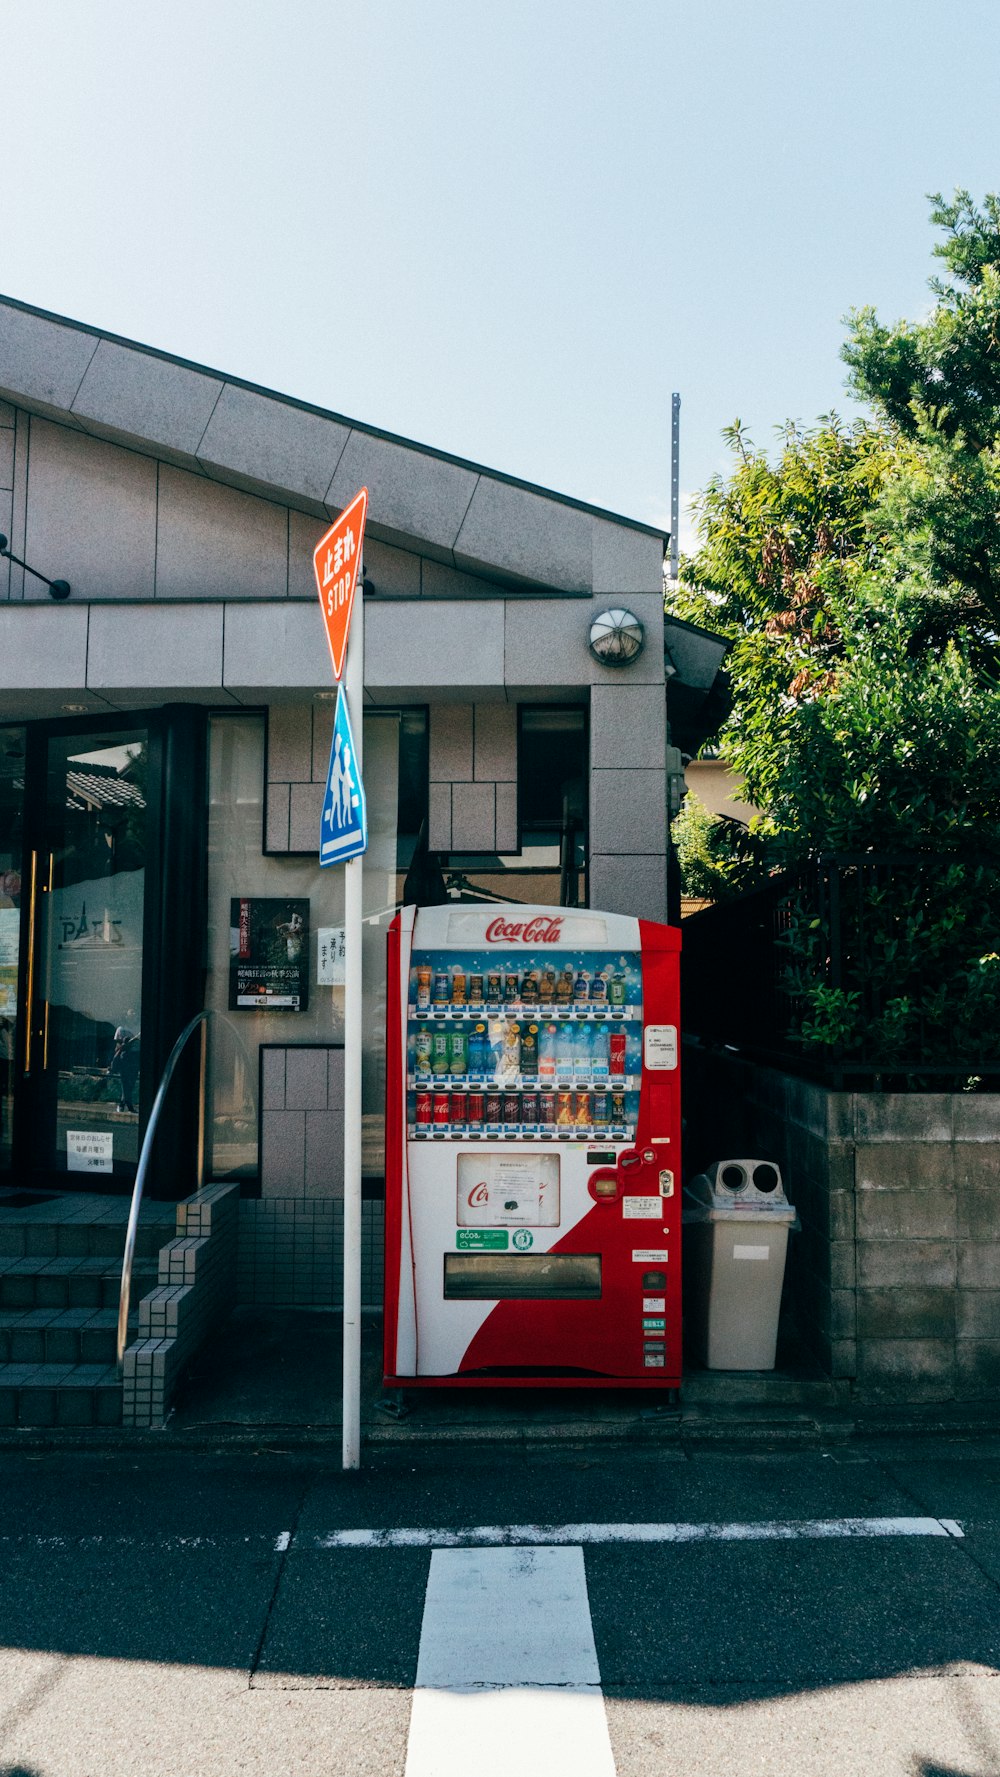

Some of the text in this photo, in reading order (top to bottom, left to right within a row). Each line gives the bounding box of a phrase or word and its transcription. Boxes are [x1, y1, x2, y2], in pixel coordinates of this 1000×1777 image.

[322, 526, 356, 587] 止まれ
[327, 571, 351, 617] STOP
[485, 916, 566, 943] Coca-Cola
[69, 1134, 111, 1143] 定休日のおしらせ
